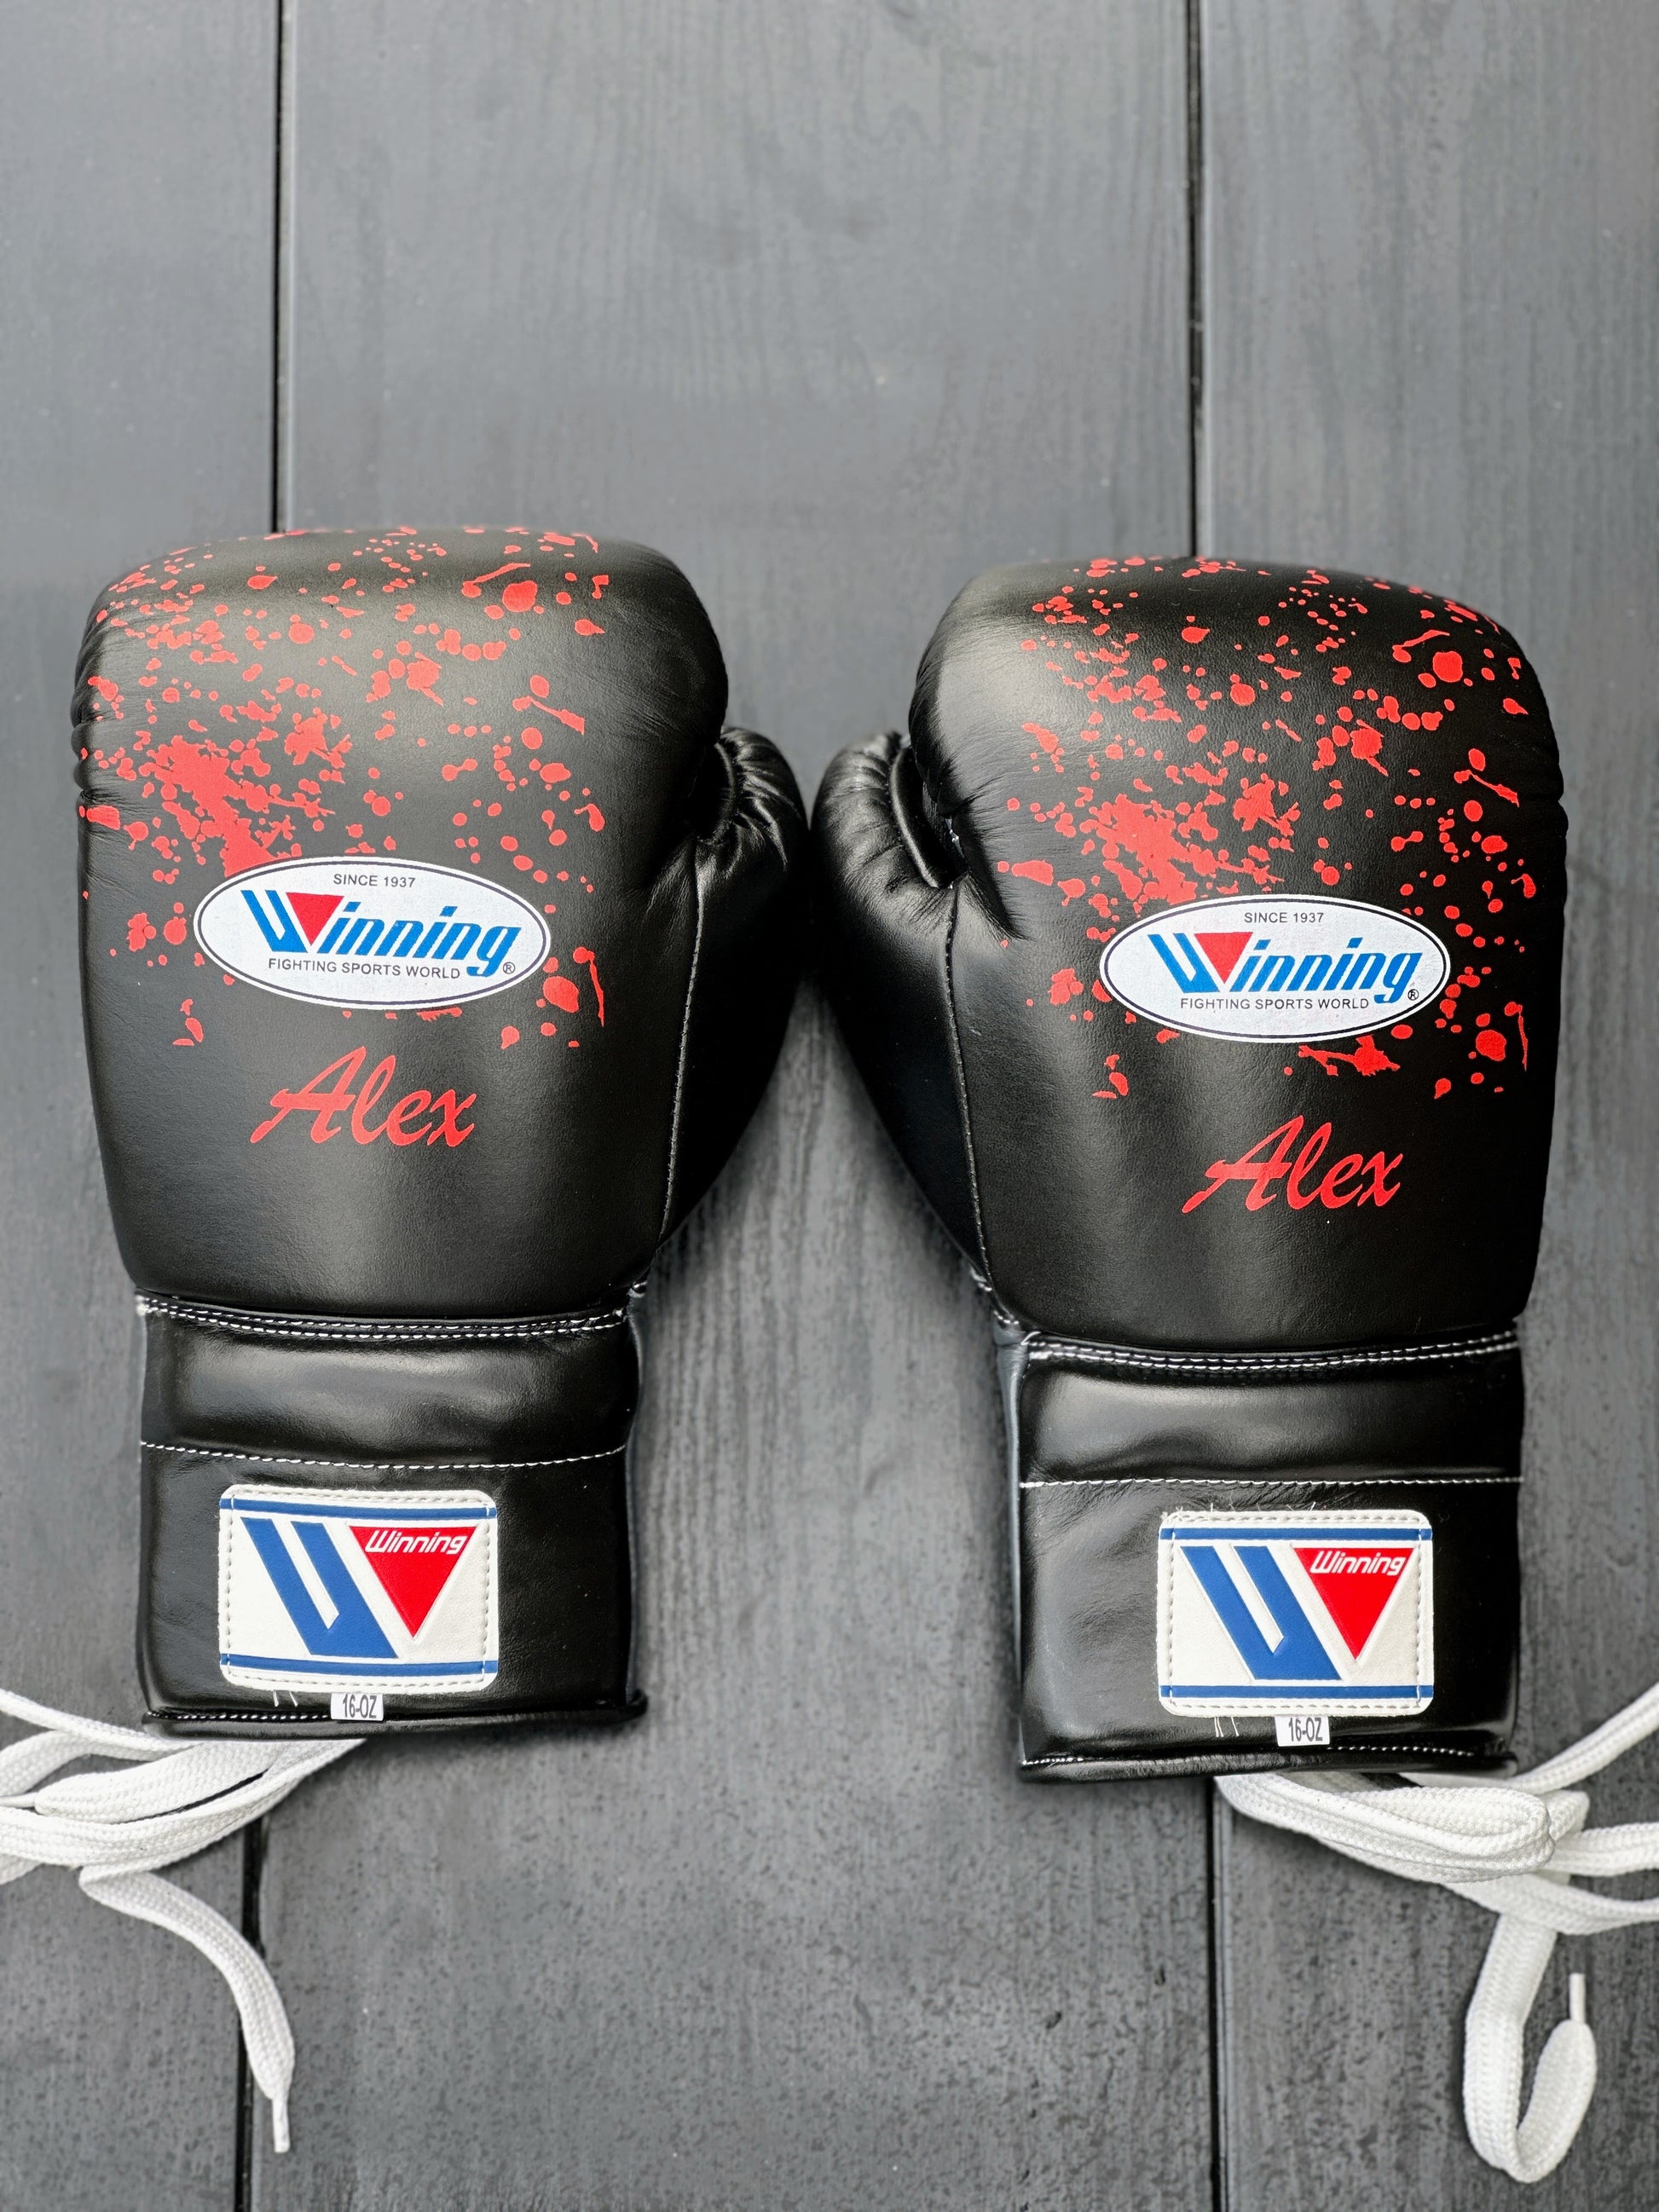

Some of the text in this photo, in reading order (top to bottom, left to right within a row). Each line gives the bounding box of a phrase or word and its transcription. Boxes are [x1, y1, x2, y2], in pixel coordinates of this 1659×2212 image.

[333, 873, 416, 889] SINCE 1937
[1244, 911, 1324, 923] SINCE 1937
[240, 889, 522, 978] Winning
[269, 957, 460, 979] FIGHTING SPORTS WORLD
[1147, 932, 1423, 1003] Winning
[1181, 996, 1369, 1010] FIGHTING SPORTS WORLD
[250, 1046, 477, 1147] Alex
[1182, 1114, 1403, 1214] Alex
[365, 1530, 468, 1555] Winning
[1309, 1551, 1407, 1576] Winning
[342, 1693, 377, 1718] 16-OZ
[1288, 1717, 1323, 1741] 16-OZ
